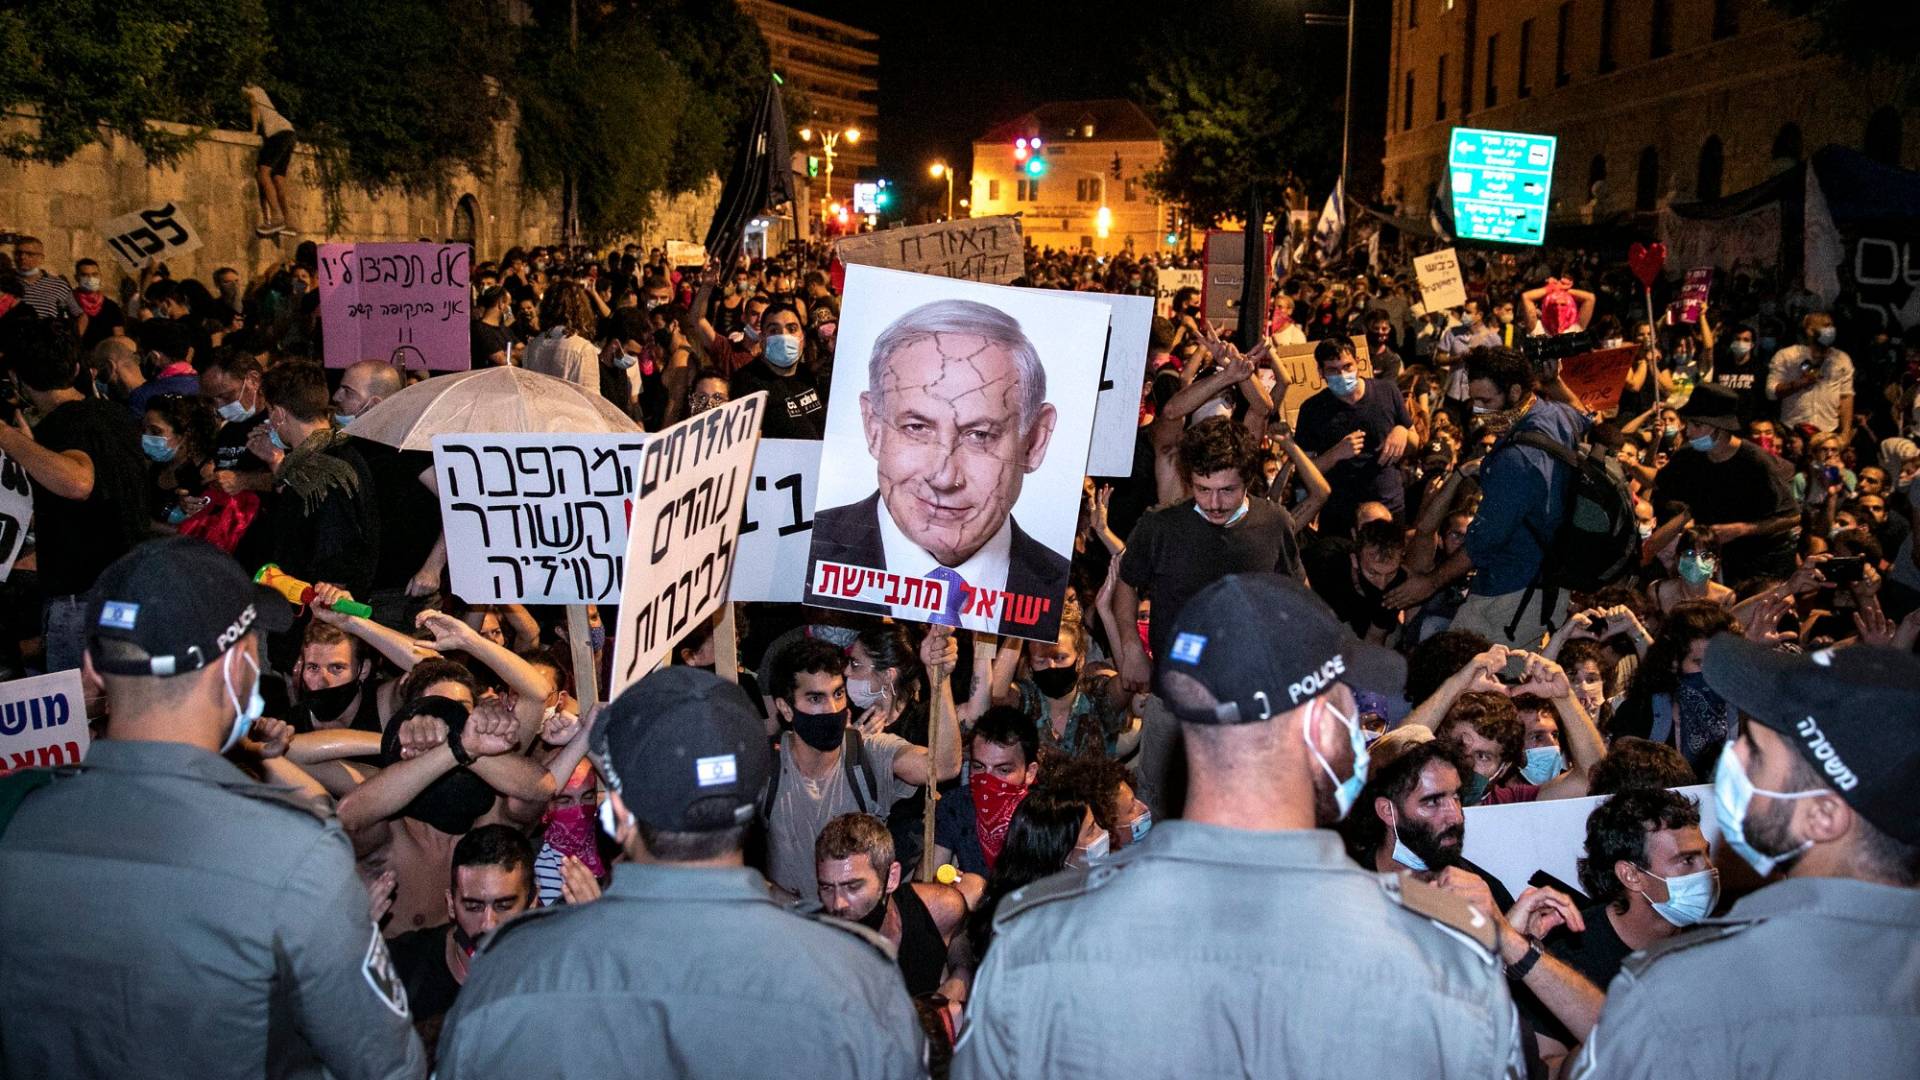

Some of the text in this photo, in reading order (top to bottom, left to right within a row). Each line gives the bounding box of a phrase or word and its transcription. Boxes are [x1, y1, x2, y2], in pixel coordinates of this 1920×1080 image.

[108, 202, 189, 267] לכו!
[321, 247, 467, 288] אל תרביצו לי!
[347, 300, 464, 321] אני בתקופה קשה
[640, 397, 758, 500] האזרחים
[451, 501, 611, 554] תשודר
[651, 465, 737, 565] נוהרים
[626, 524, 732, 681] לכיכרות
[818, 563, 1051, 626] ישראל מתביישת
[216, 603, 257, 652] POLICE
[1288, 654, 1346, 704] POLICE
[1797, 716, 1859, 791] משטרה
